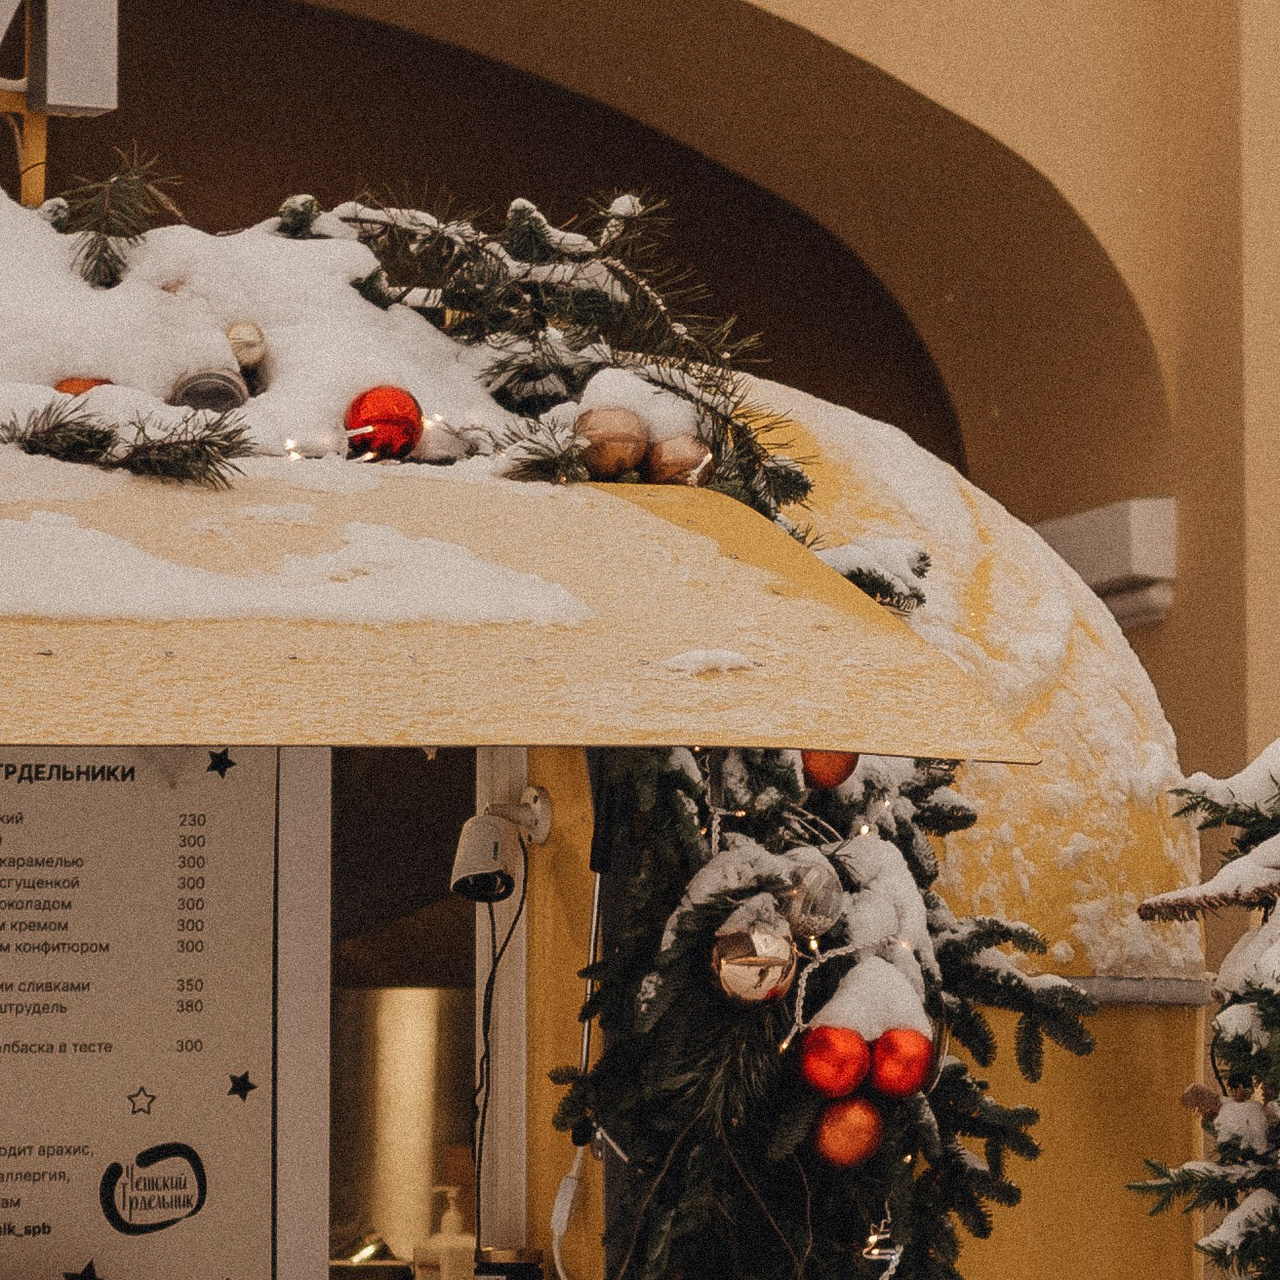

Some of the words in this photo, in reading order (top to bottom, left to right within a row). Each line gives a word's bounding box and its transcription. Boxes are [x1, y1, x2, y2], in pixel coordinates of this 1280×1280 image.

[179, 813, 206, 827] 230
[178, 834, 206, 848] 300
[178, 855, 205, 869] 300
[0, 876, 80, 892] сгущенкой
[177, 876, 205, 891] 300
[177, 897, 205, 911] 300
[10, 921, 69, 934] кремом
[177, 919, 204, 932] 300
[14, 940, 110, 955] конфитюром
[177, 940, 204, 953] 300
[18, 980, 91, 993] сливками
[176, 979, 204, 992] 350
[176, 999, 204, 1013] 380
[0, 1040, 53, 1054] лбаска
[59, 1042, 67, 1053] в
[72, 1040, 113, 1053] тесте
[176, 1039, 203, 1052] 300
[37, 1145, 94, 1158] арахис,
